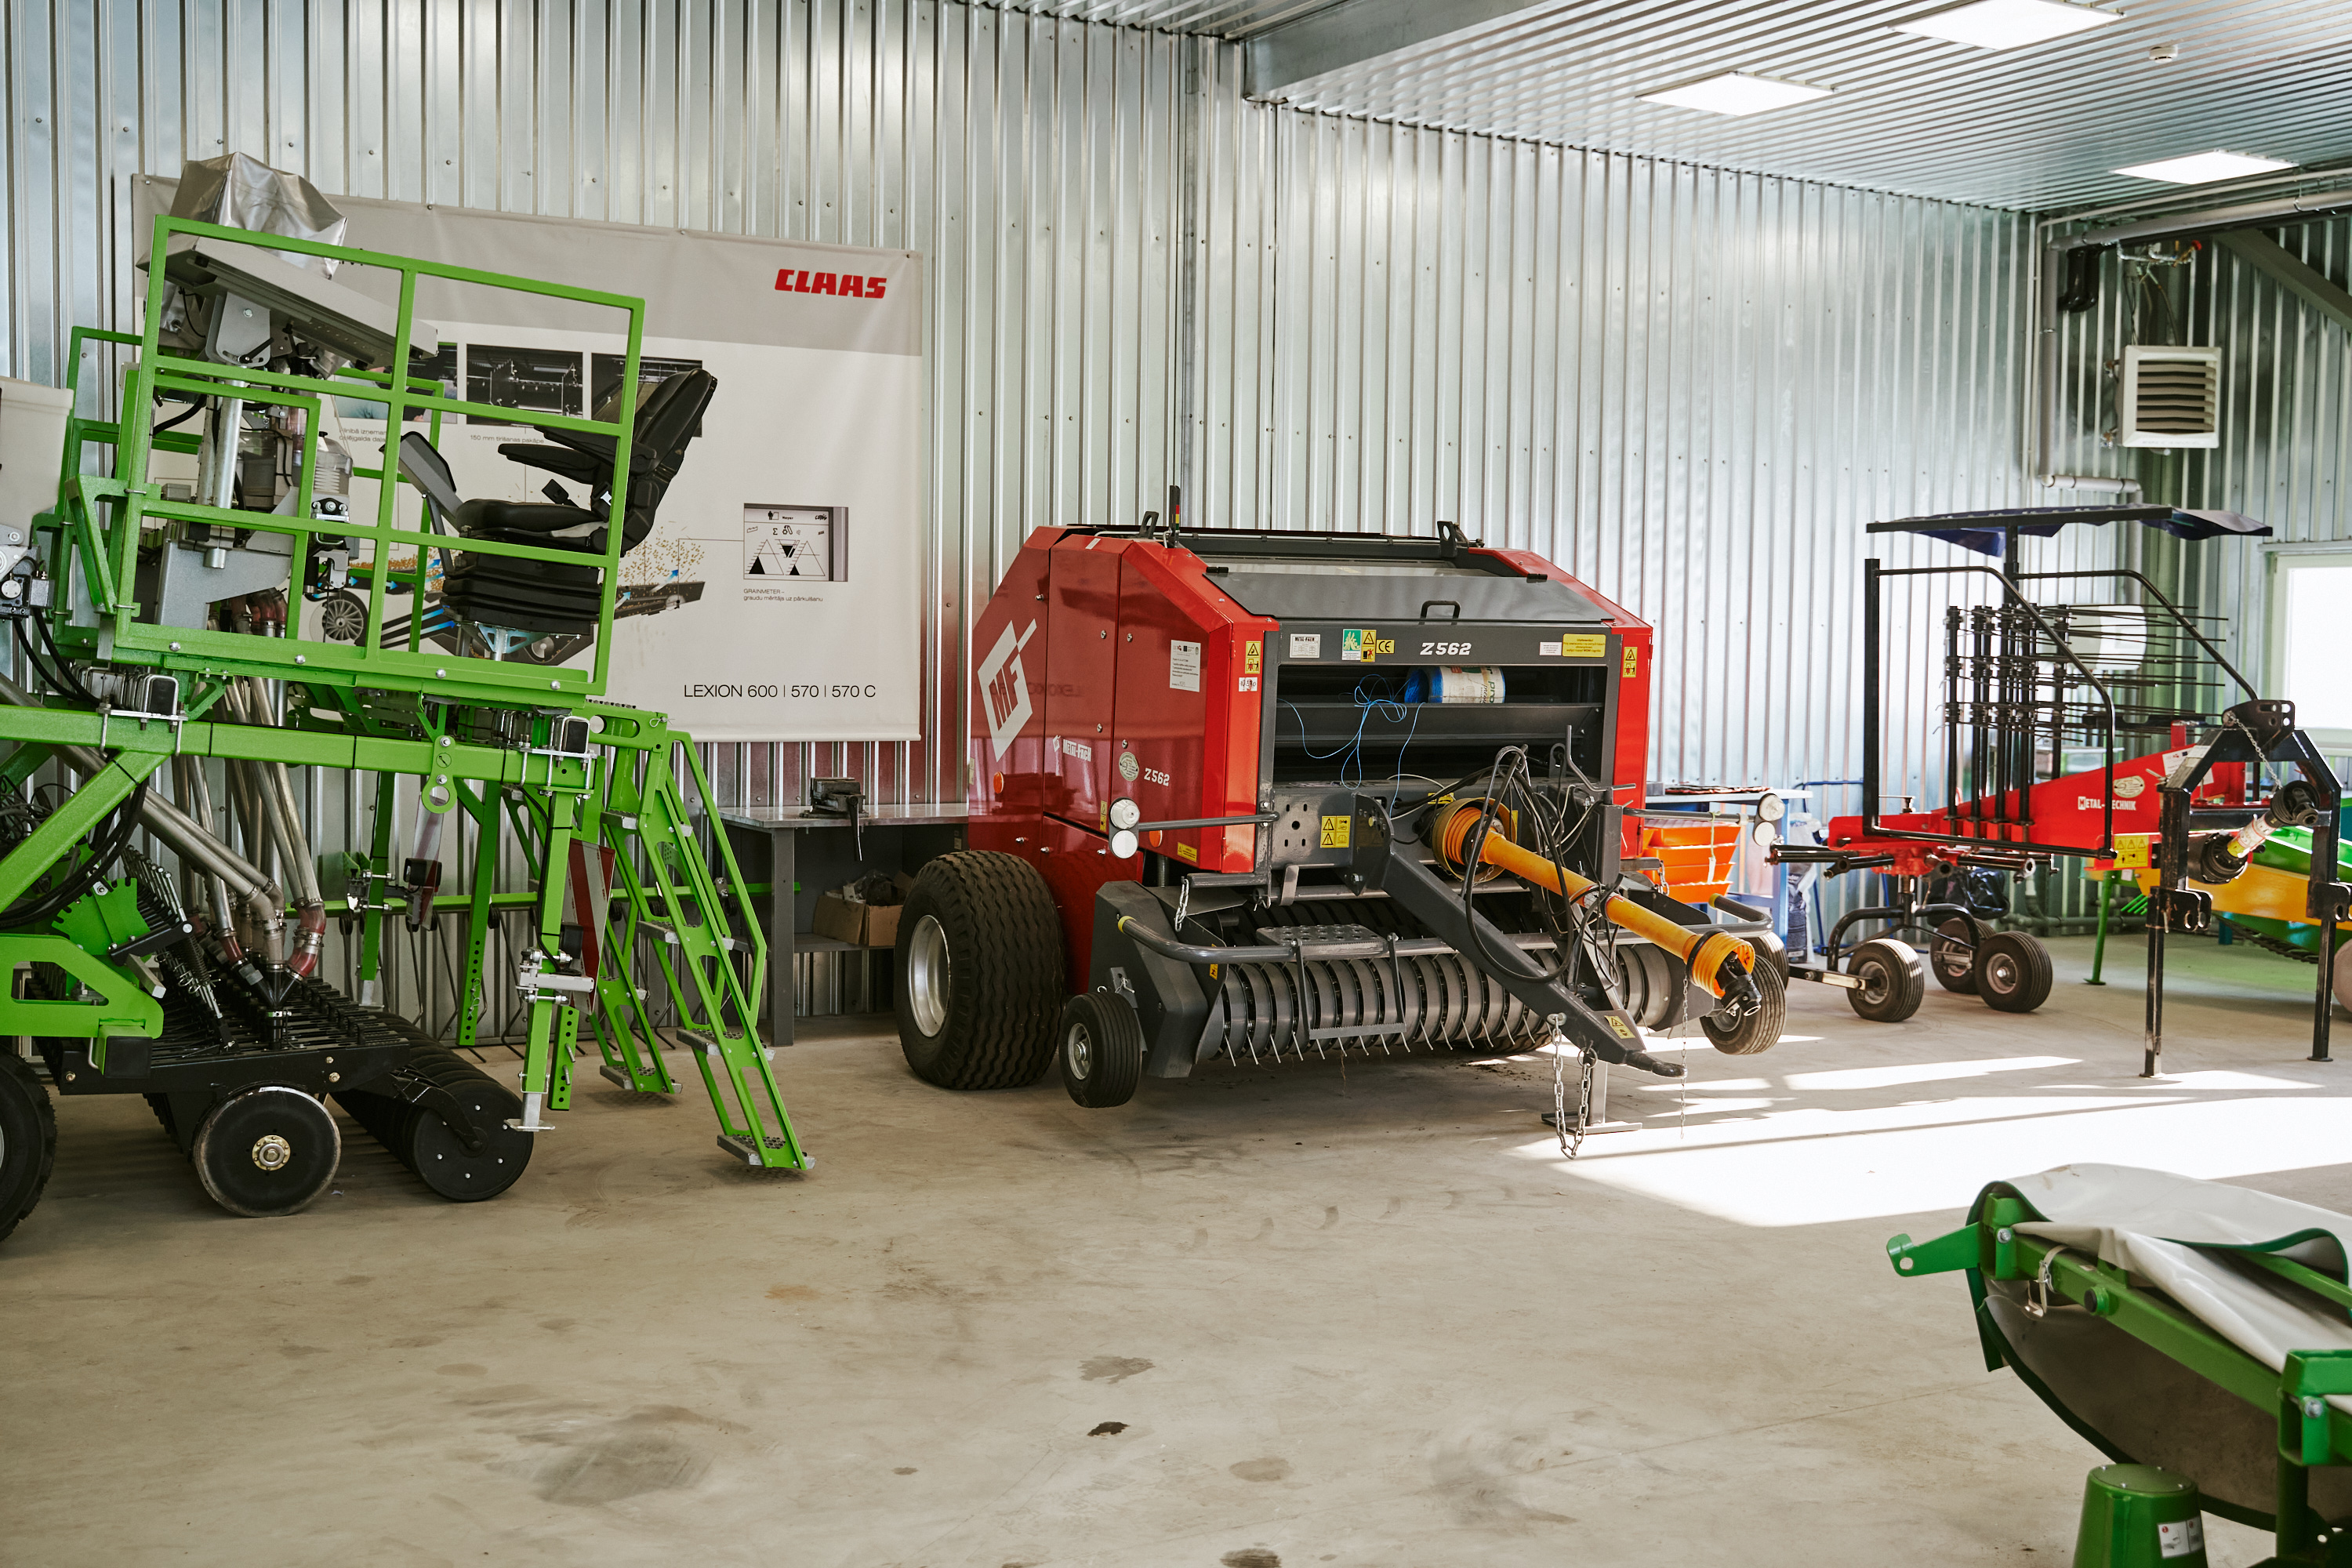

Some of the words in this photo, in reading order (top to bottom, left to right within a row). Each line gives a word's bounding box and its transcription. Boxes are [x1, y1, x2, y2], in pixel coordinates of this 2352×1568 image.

[775, 268, 887, 299] CLAAS
[684, 684, 742, 698] LEXION
[747, 684, 778, 698] 600
[791, 684, 819, 698] 570
[832, 684, 860, 698] 570
[864, 684, 877, 698] C
[2078, 796, 2136, 811] METAL-ECHNIK
